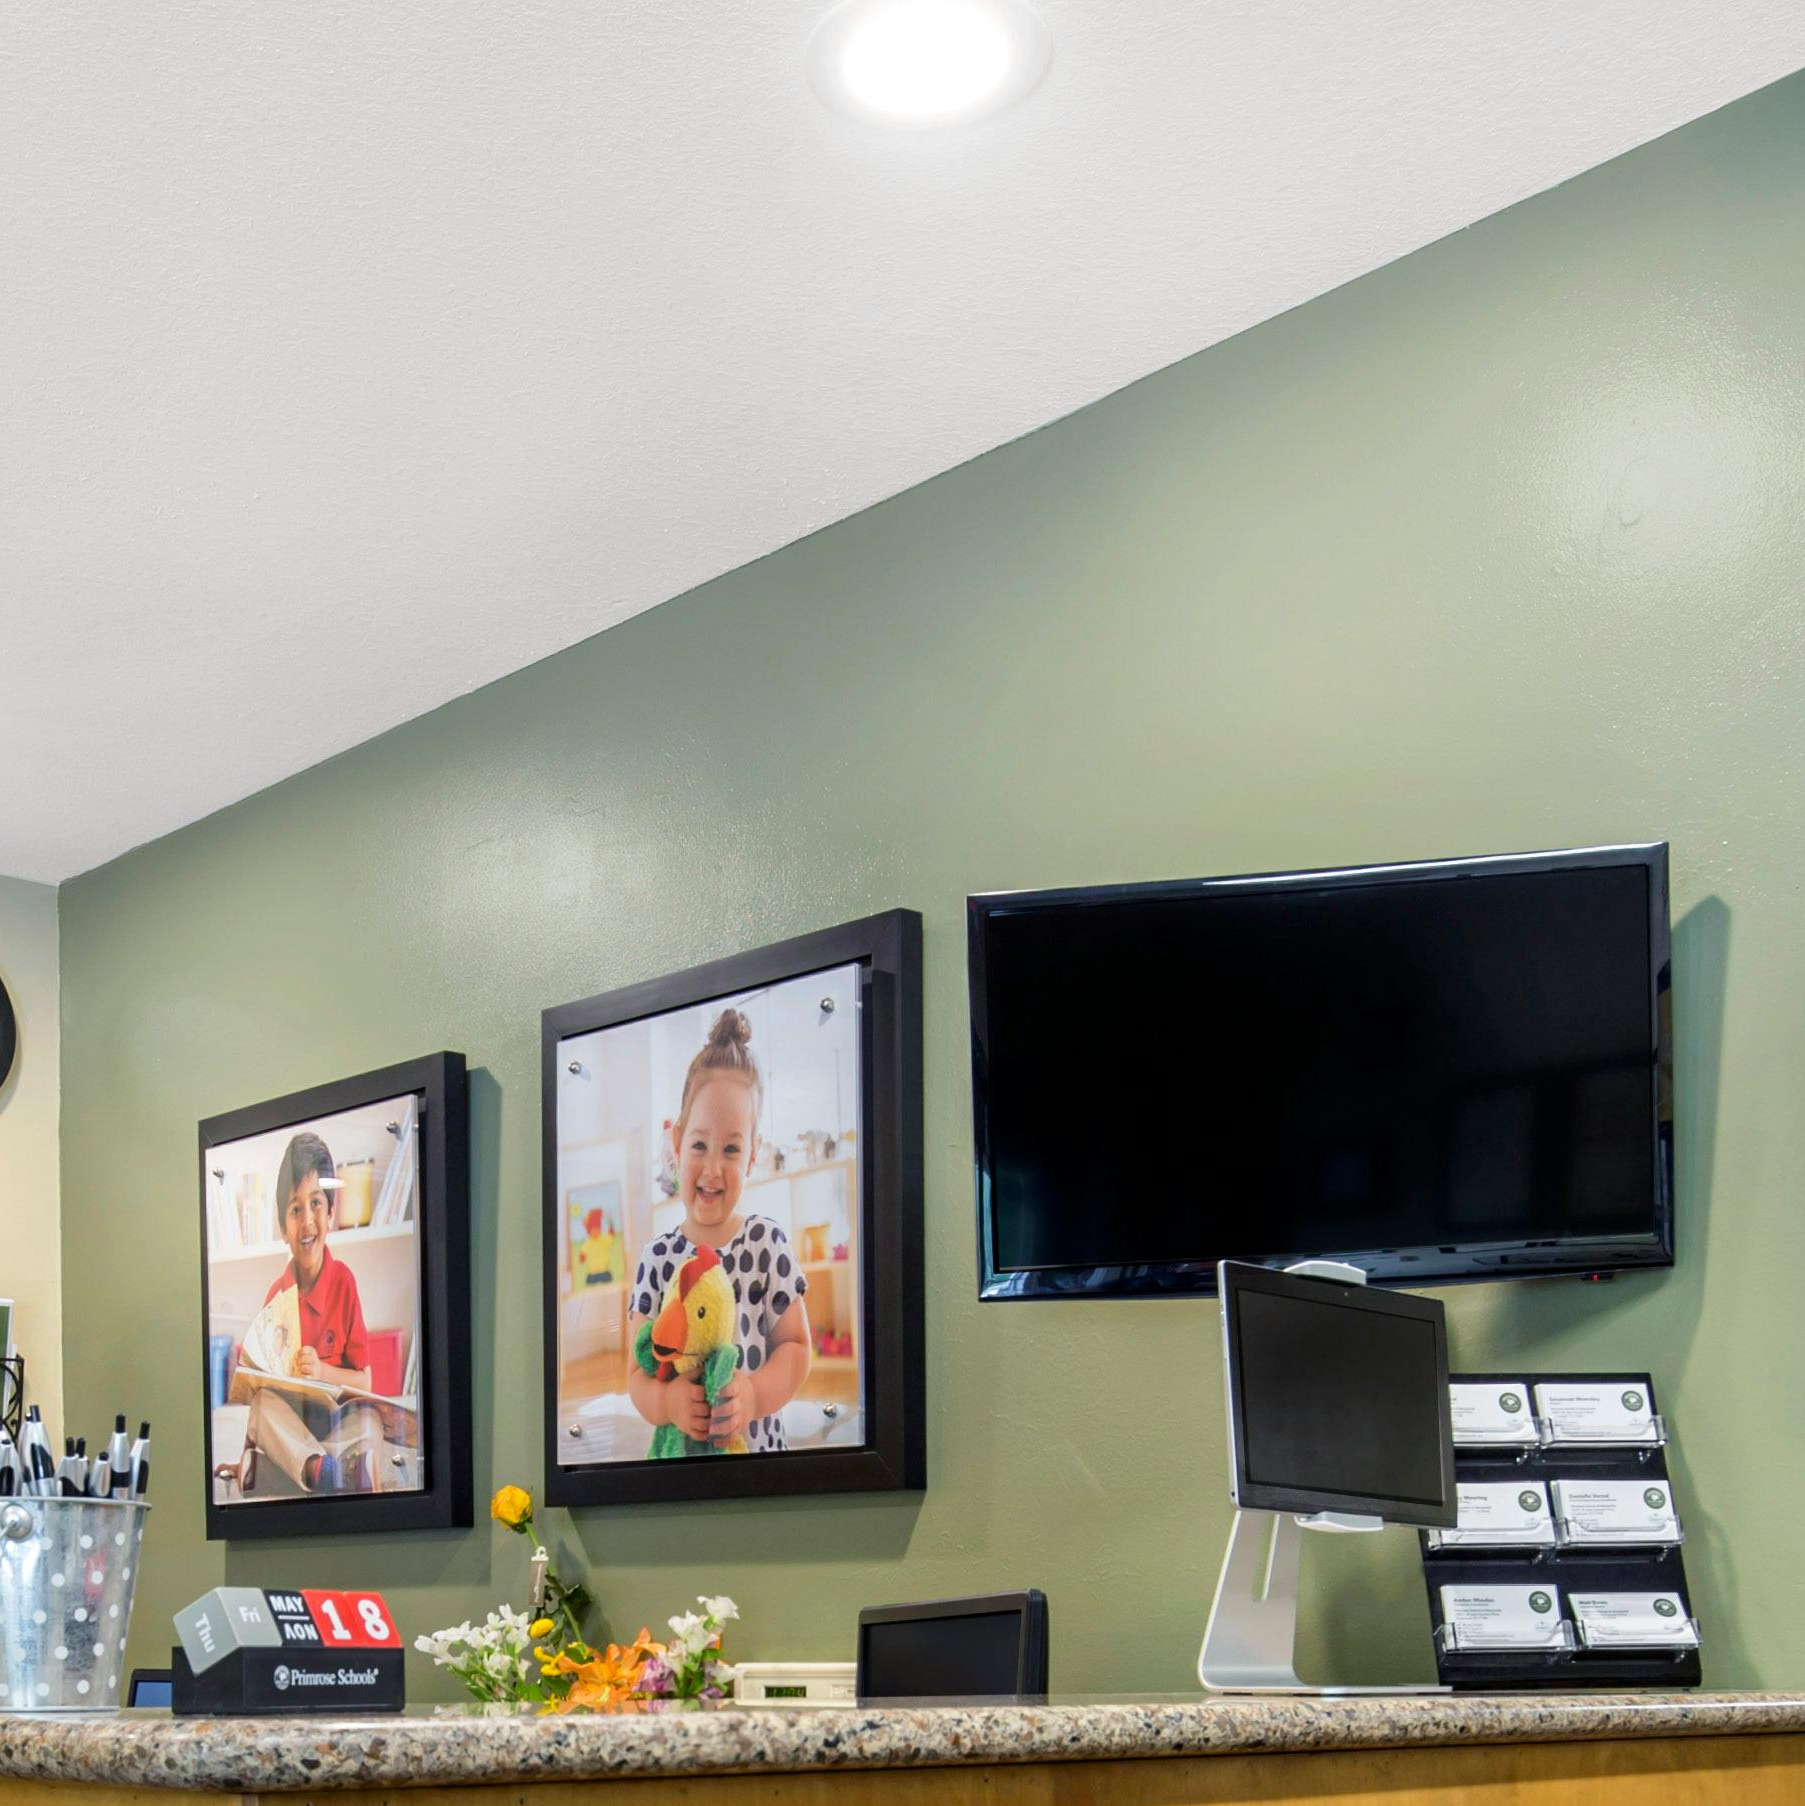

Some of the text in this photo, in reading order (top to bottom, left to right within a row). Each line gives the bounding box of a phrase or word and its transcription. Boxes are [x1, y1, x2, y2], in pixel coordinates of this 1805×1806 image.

[269, 1596, 304, 1612] MAY
[239, 1606, 261, 1623] Fri
[195, 1612, 215, 1653] Thu
[282, 1623, 318, 1640] NOV
[291, 1668, 336, 1686] Primrose
